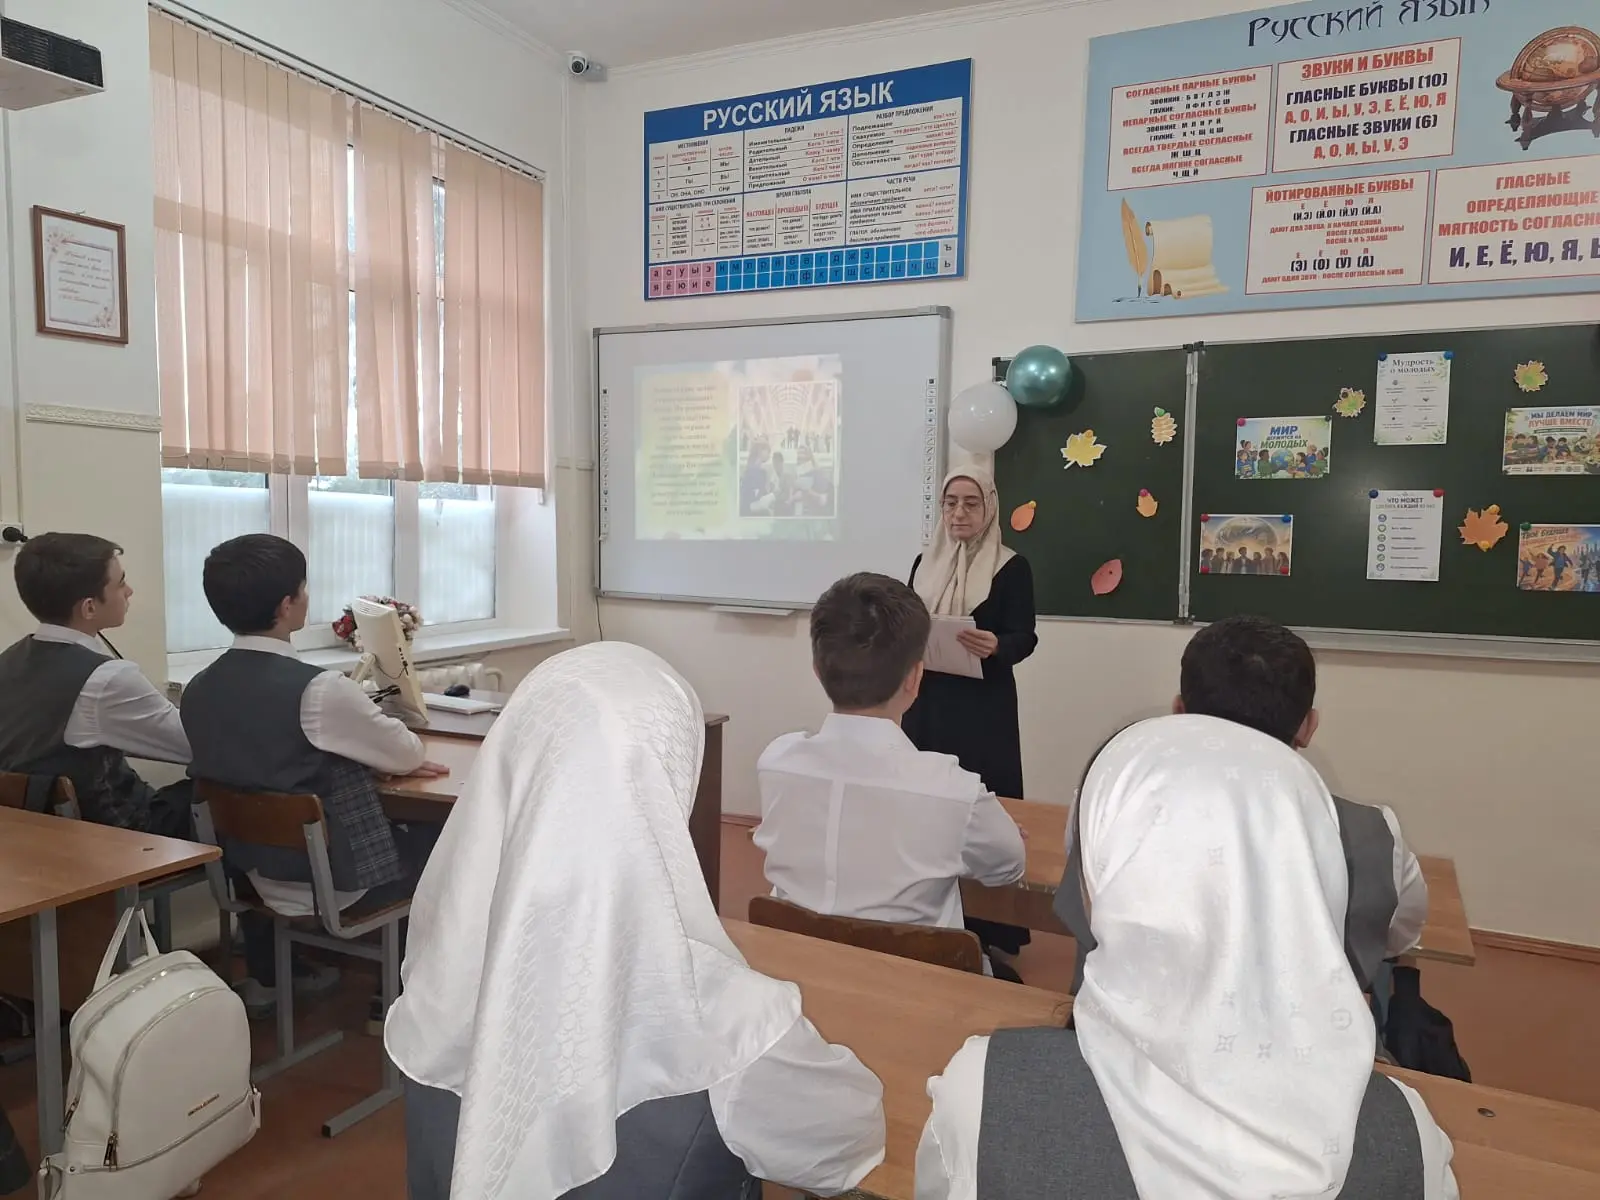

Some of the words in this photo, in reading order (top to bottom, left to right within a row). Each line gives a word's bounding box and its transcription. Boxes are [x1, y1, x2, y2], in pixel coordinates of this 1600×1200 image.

[1302, 58, 1353, 78] ЗВУКИ
[1358, 56, 1368, 71] И
[1372, 47, 1434, 68] БУКВЫ
[1126, 82, 1180, 98] СОГЛАСНЫЕ
[1182, 79, 1220, 91] ПАРНЫЕ
[1223, 74, 1256, 83] БУКВЫ
[1287, 85, 1355, 105] ГЛАСНЫЕ
[1360, 77, 1414, 96] БУКВЫ
[1418, 73, 1447, 88] (10)
[704, 88, 812, 130] РУССКИЙ
[820, 80, 894, 112] ЯЗЫК
[1123, 114, 1167, 127] НЕПАРНЫЕ
[1170, 108, 1221, 120] СОГЛАСНЫЕ
[1224, 104, 1256, 113] БУКВЫ
[1285, 111, 1296, 124] А,
[1301, 109, 1312, 122] О,
[1316, 107, 1328, 120] И,
[1333, 104, 1350, 118] Ы,
[1354, 103, 1364, 115] У,
[1369, 101, 1381, 114] Э,
[1385, 99, 1395, 112] Е,
[1399, 95, 1409, 111] Ё,
[1414, 95, 1431, 108] Ю,
[1436, 92, 1446, 106] Я
[1290, 123, 1359, 143] ГЛАСНЫЕ
[1363, 117, 1411, 135] ЗВУКИ
[1416, 115, 1437, 129] (6)
[1123, 144, 1155, 155] ВСЕГДА
[1199, 133, 1253, 146] СОГЛАСНЫЕ
[1314, 147, 1326, 159] А,
[1330, 144, 1341, 157] О,
[1346, 143, 1358, 156] И,
[1362, 140, 1380, 154] Ы,
[1384, 139, 1394, 151] У,
[1399, 137, 1408, 150] Э
[1132, 164, 1161, 173] ВСЕГДА
[1195, 155, 1243, 166] СОГЛАСНЫЕ
[1266, 183, 1364, 202] ЙОТИРОВАННЫЕ
[1368, 178, 1414, 192] БУКВЫ
[1496, 172, 1570, 190] ГЛАСНЫЕ
[1467, 191, 1599, 213] ОПРЕДЕЛЯЮЩИЕ
[1439, 220, 1518, 236] МЯГКОСТЬ
[1291, 260, 1307, 272] (Э)
[1313, 259, 1329, 270] (О)
[1336, 257, 1351, 269] (У)
[1357, 256, 1374, 267] (А)
[1450, 247, 1470, 268] И,
[1477, 246, 1493, 267] Е,
[1500, 240, 1517, 266] Ё,
[1524, 242, 1554, 263] Ю,
[1561, 240, 1584, 262] Я,
[1270, 426, 1298, 435] МИР
[1261, 440, 1308, 448] МОЛОДЫХ
